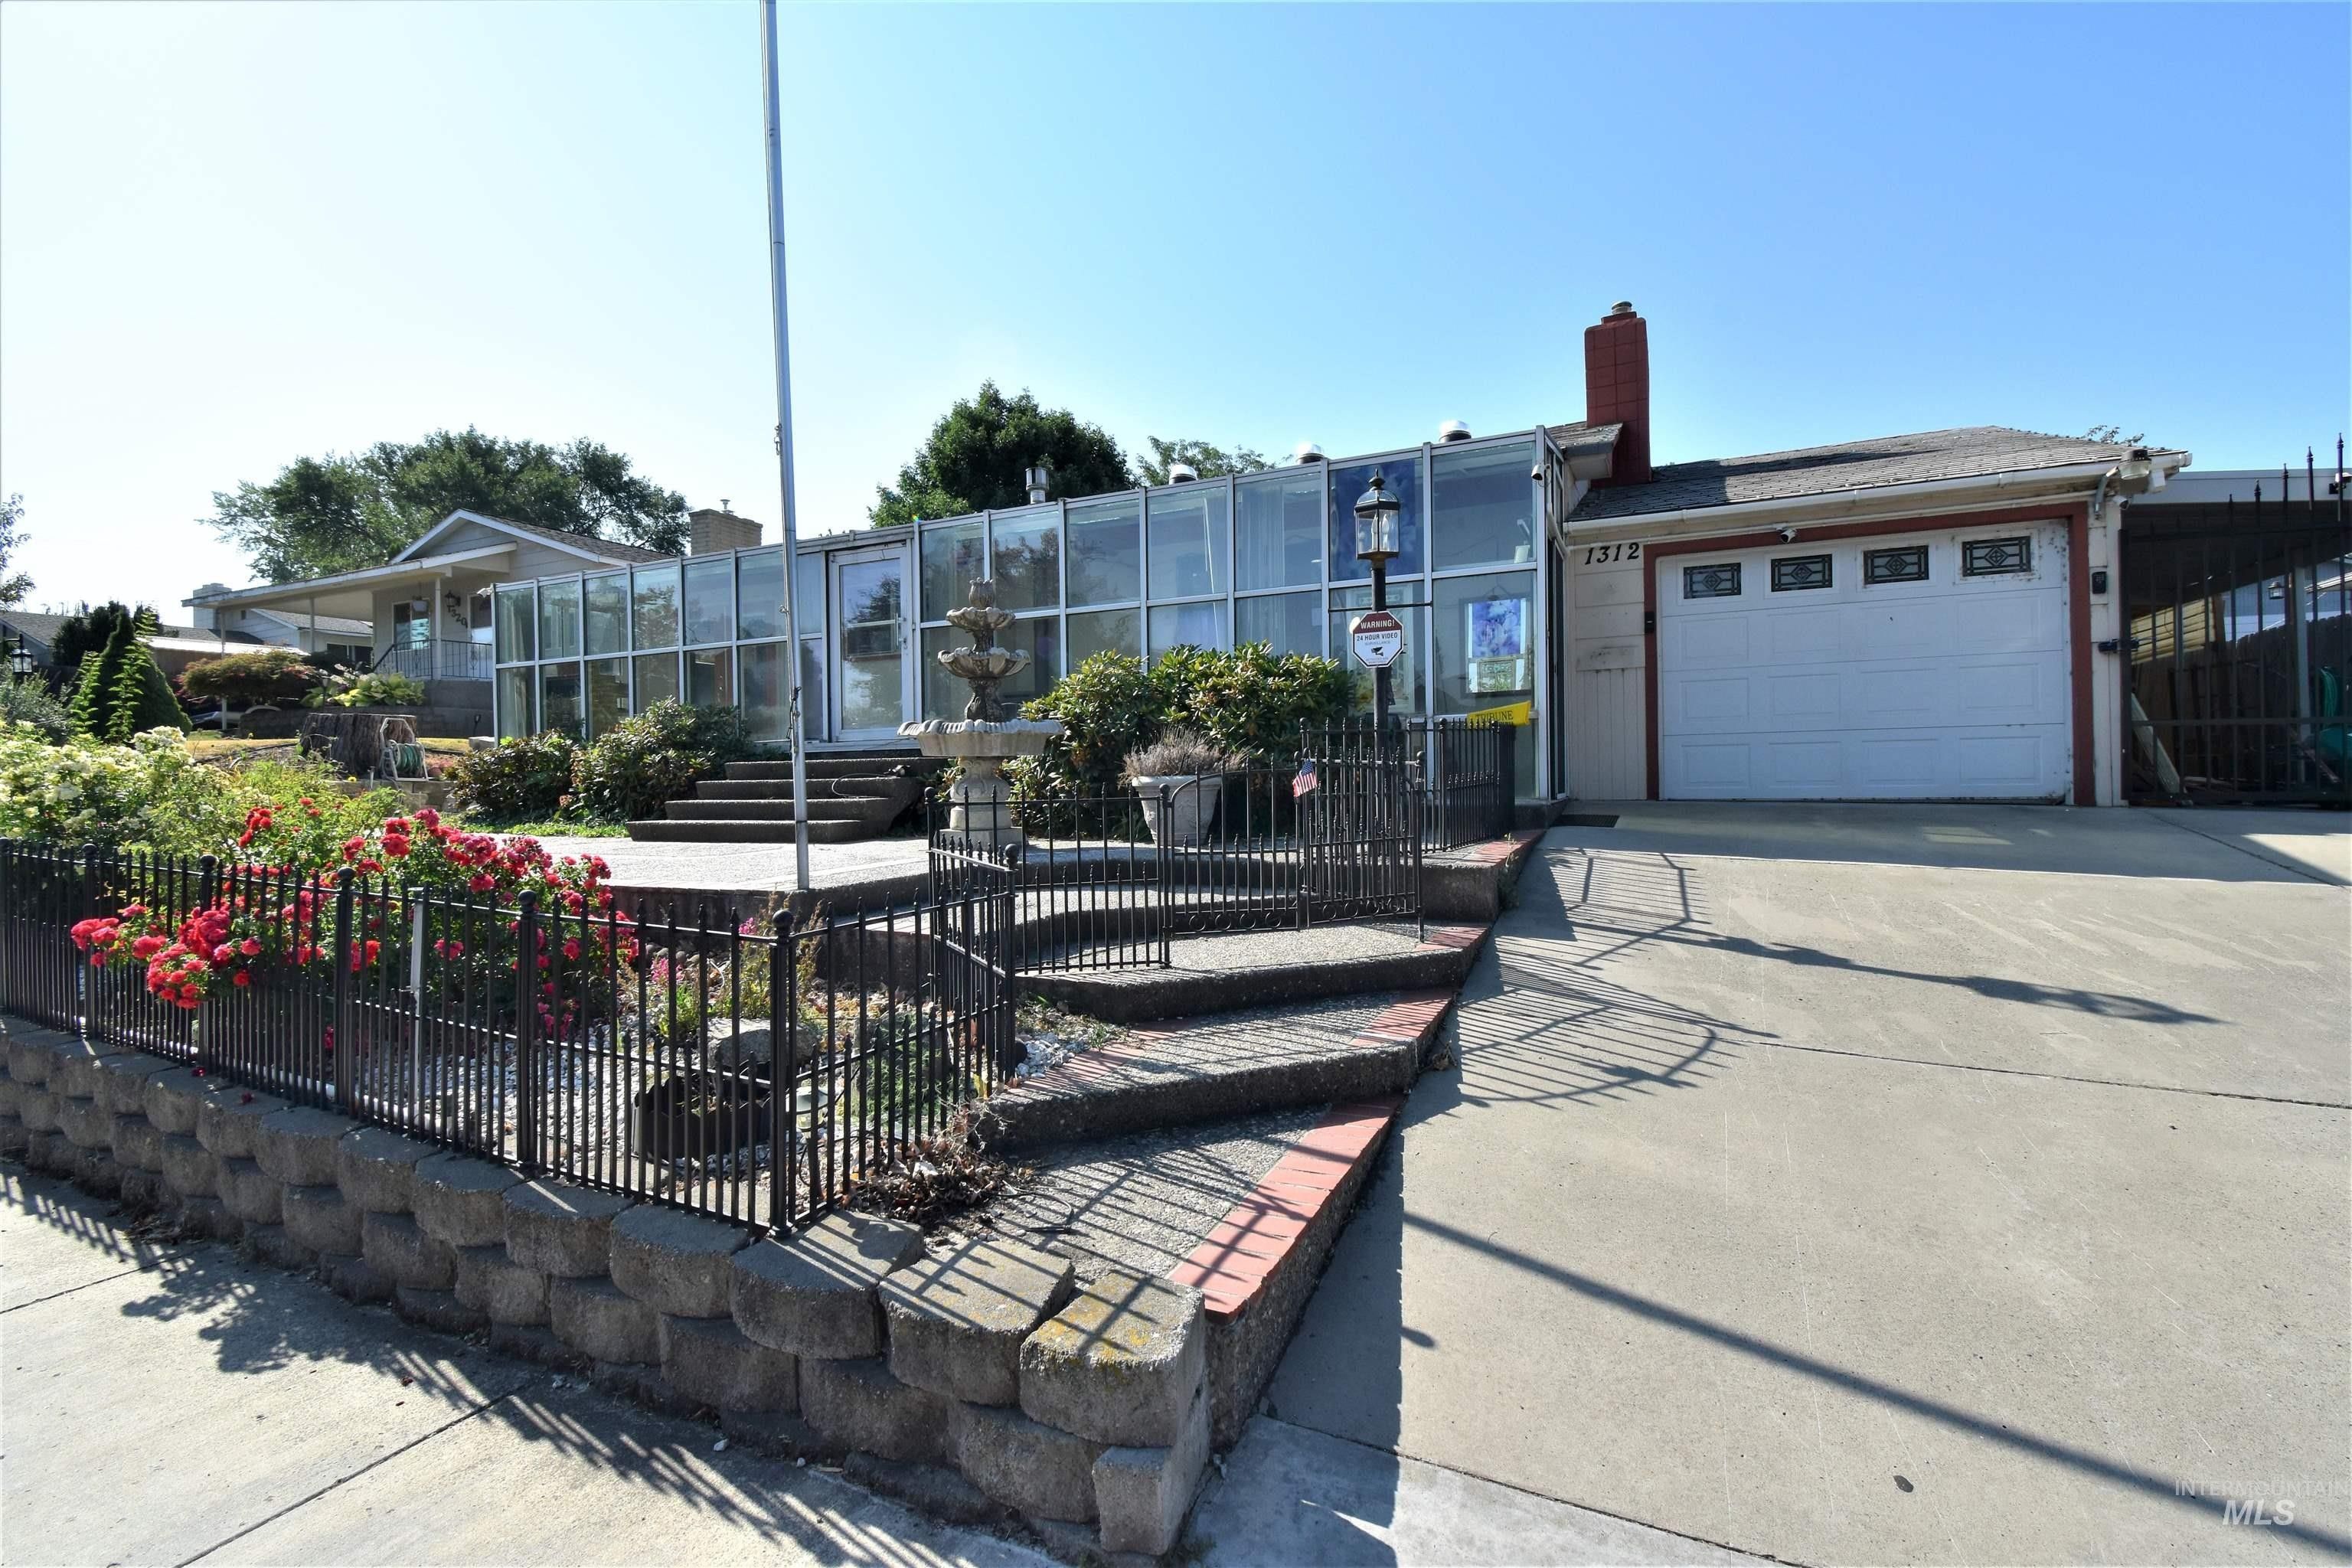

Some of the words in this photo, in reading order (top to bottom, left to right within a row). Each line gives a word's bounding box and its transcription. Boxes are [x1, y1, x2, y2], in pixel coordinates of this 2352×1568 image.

[1584, 542, 1640, 565] 1312
[1361, 619, 1395, 629] WARNING!
[1475, 710, 1514, 722] TRIBUNE
